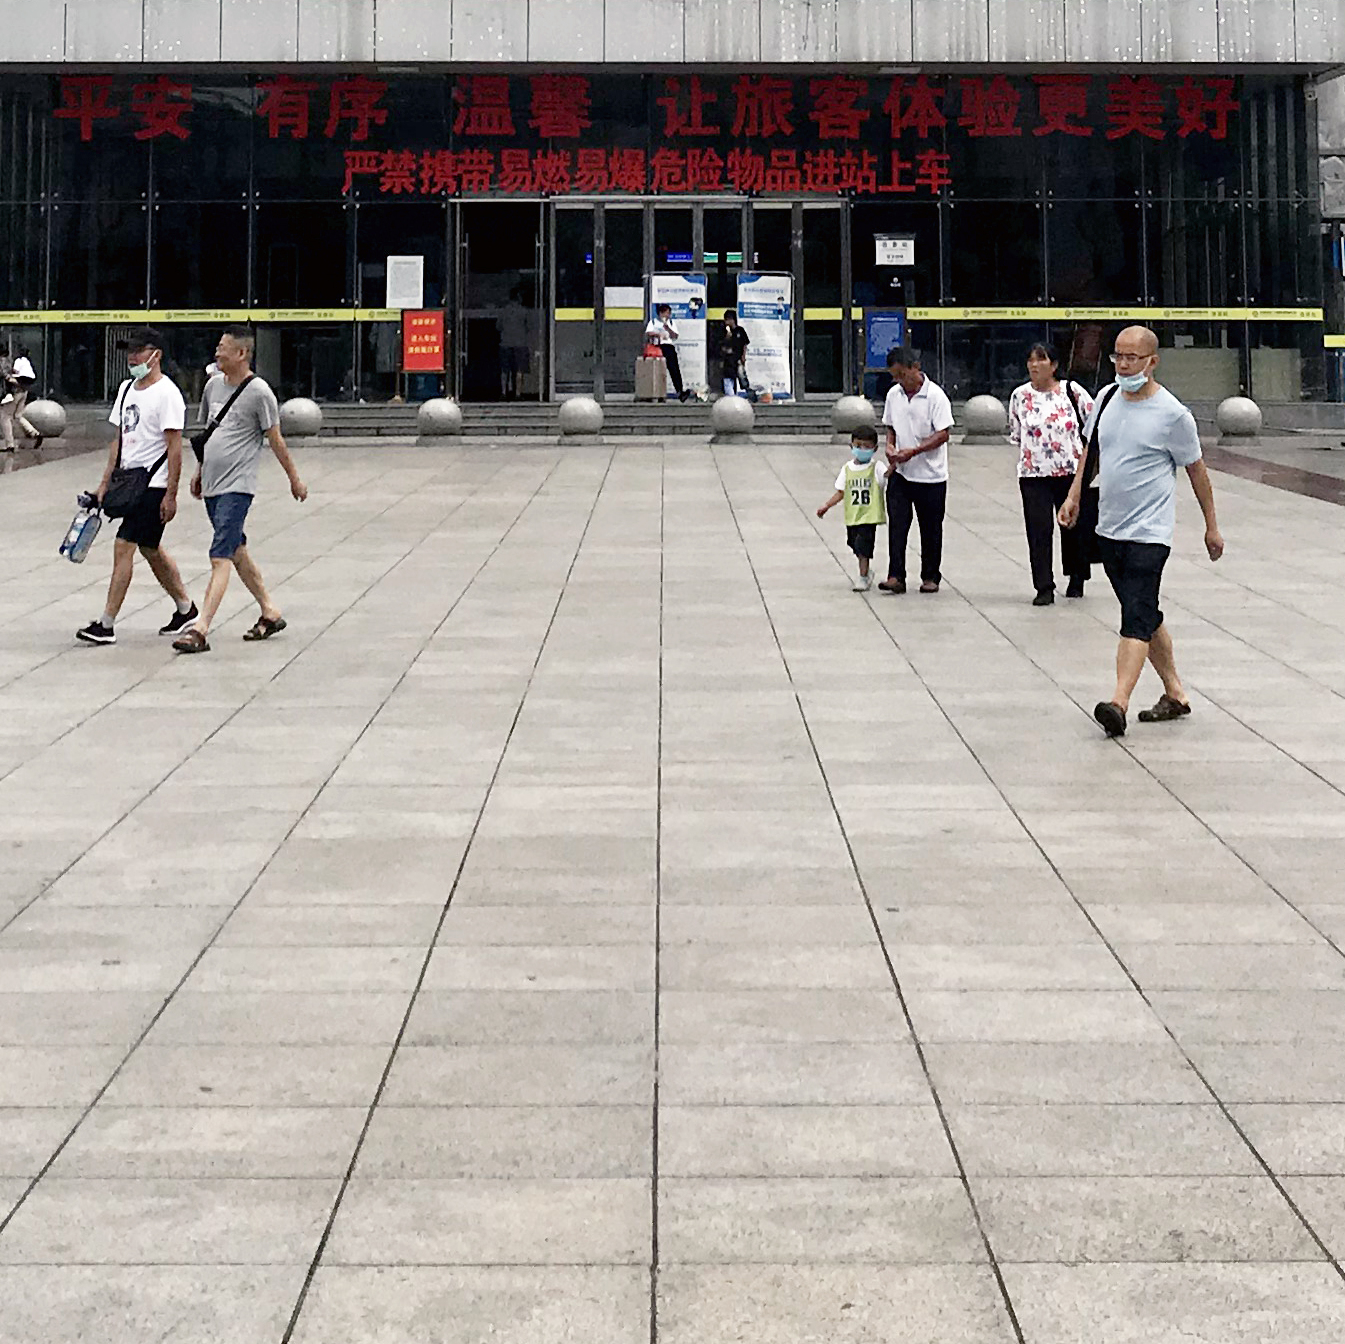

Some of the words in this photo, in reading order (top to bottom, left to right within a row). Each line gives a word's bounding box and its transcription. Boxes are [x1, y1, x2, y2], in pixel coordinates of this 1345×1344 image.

[55, 75, 193, 142] 平安
[257, 75, 388, 141] 有序
[453, 75, 593, 139] 温馨
[657, 74, 1241, 141] 让旅客体验更美好
[342, 148, 952, 195] 严禁携带易燃易爆危险物品进站上车
